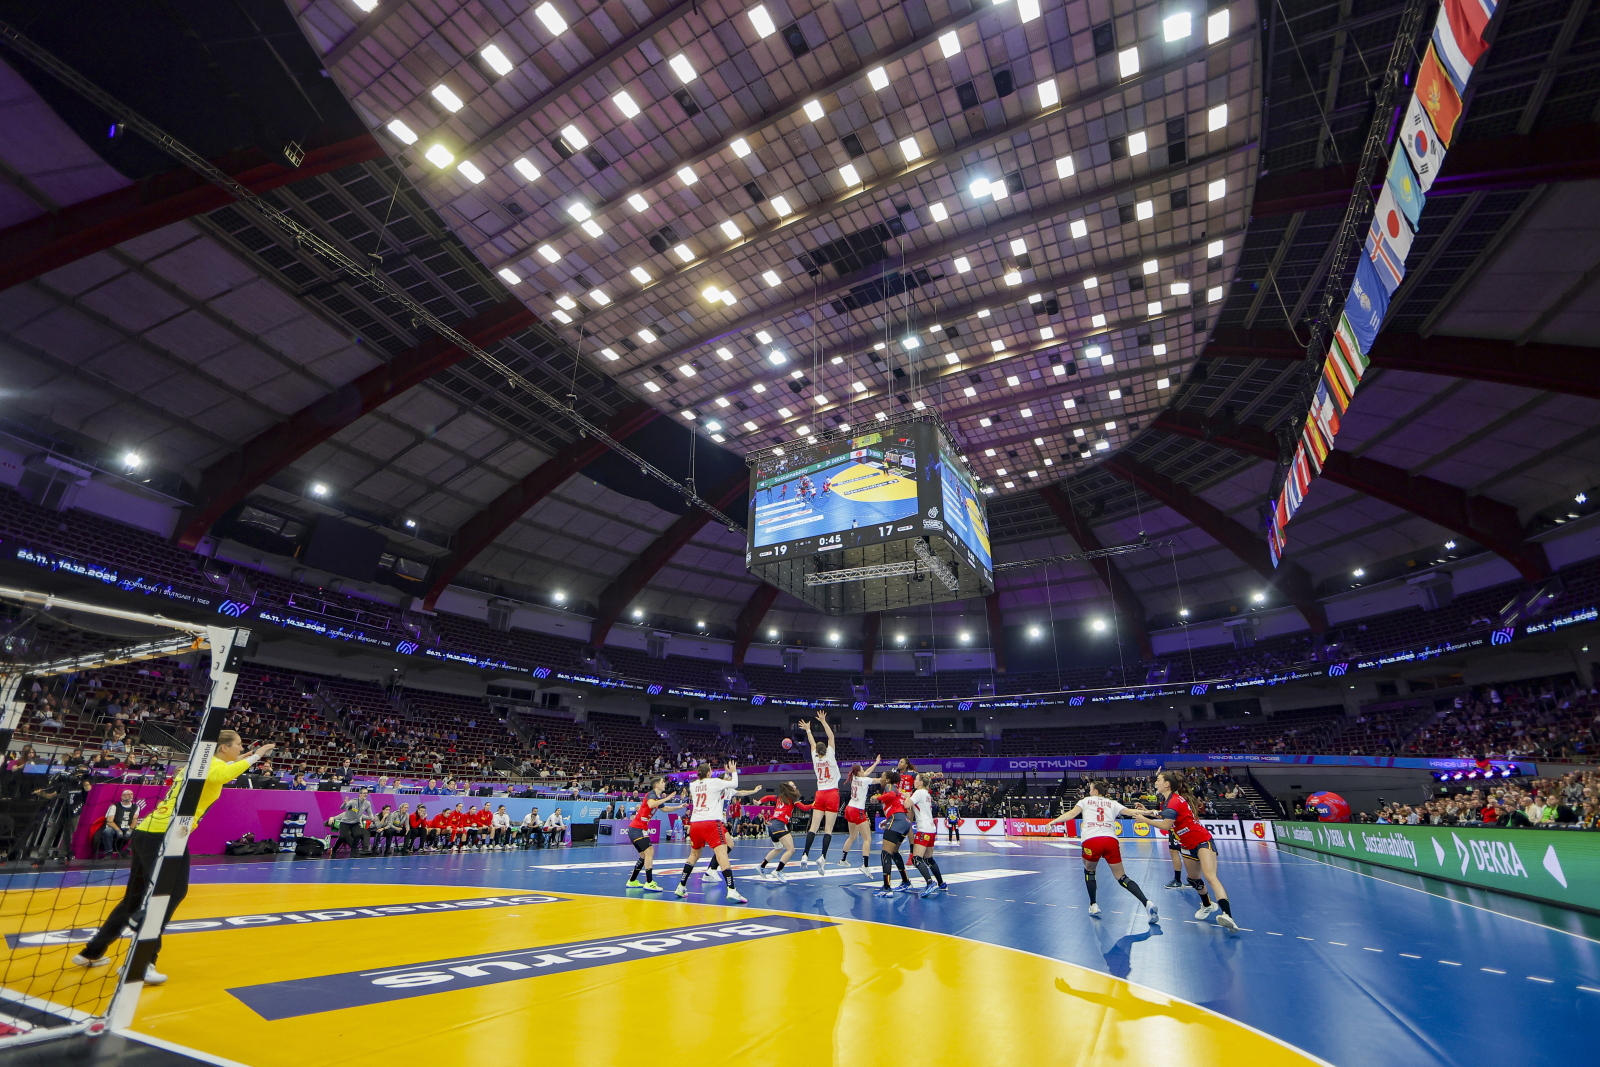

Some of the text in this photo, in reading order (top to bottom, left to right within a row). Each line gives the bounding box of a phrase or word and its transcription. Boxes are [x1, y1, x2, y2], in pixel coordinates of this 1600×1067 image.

[819, 534, 841, 545] 0:45
[879, 525, 893, 536] 17
[774, 545, 787, 556] 19
[17, 550, 48, 564] 26.11.
[58, 561, 118, 582] 14.12.2025
[124, 580, 158, 592] DORTMUND
[1526, 624, 1548, 633] 26.11.
[1552, 610, 1598, 626] 14.12.2025
[198, 744, 212, 778] interplastic
[1010, 760, 1087, 769] DORTMUND
[818, 767, 830, 780] 24
[696, 793, 706, 807] 72
[1096, 808, 1105, 822] 3
[1292, 826, 1315, 846] Sustainability
[1329, 829, 1346, 848] DEKRA
[1362, 832, 1418, 867] Sustainability
[1469, 839, 1528, 878] DEKRA
[371, 924, 790, 988] Buderus
